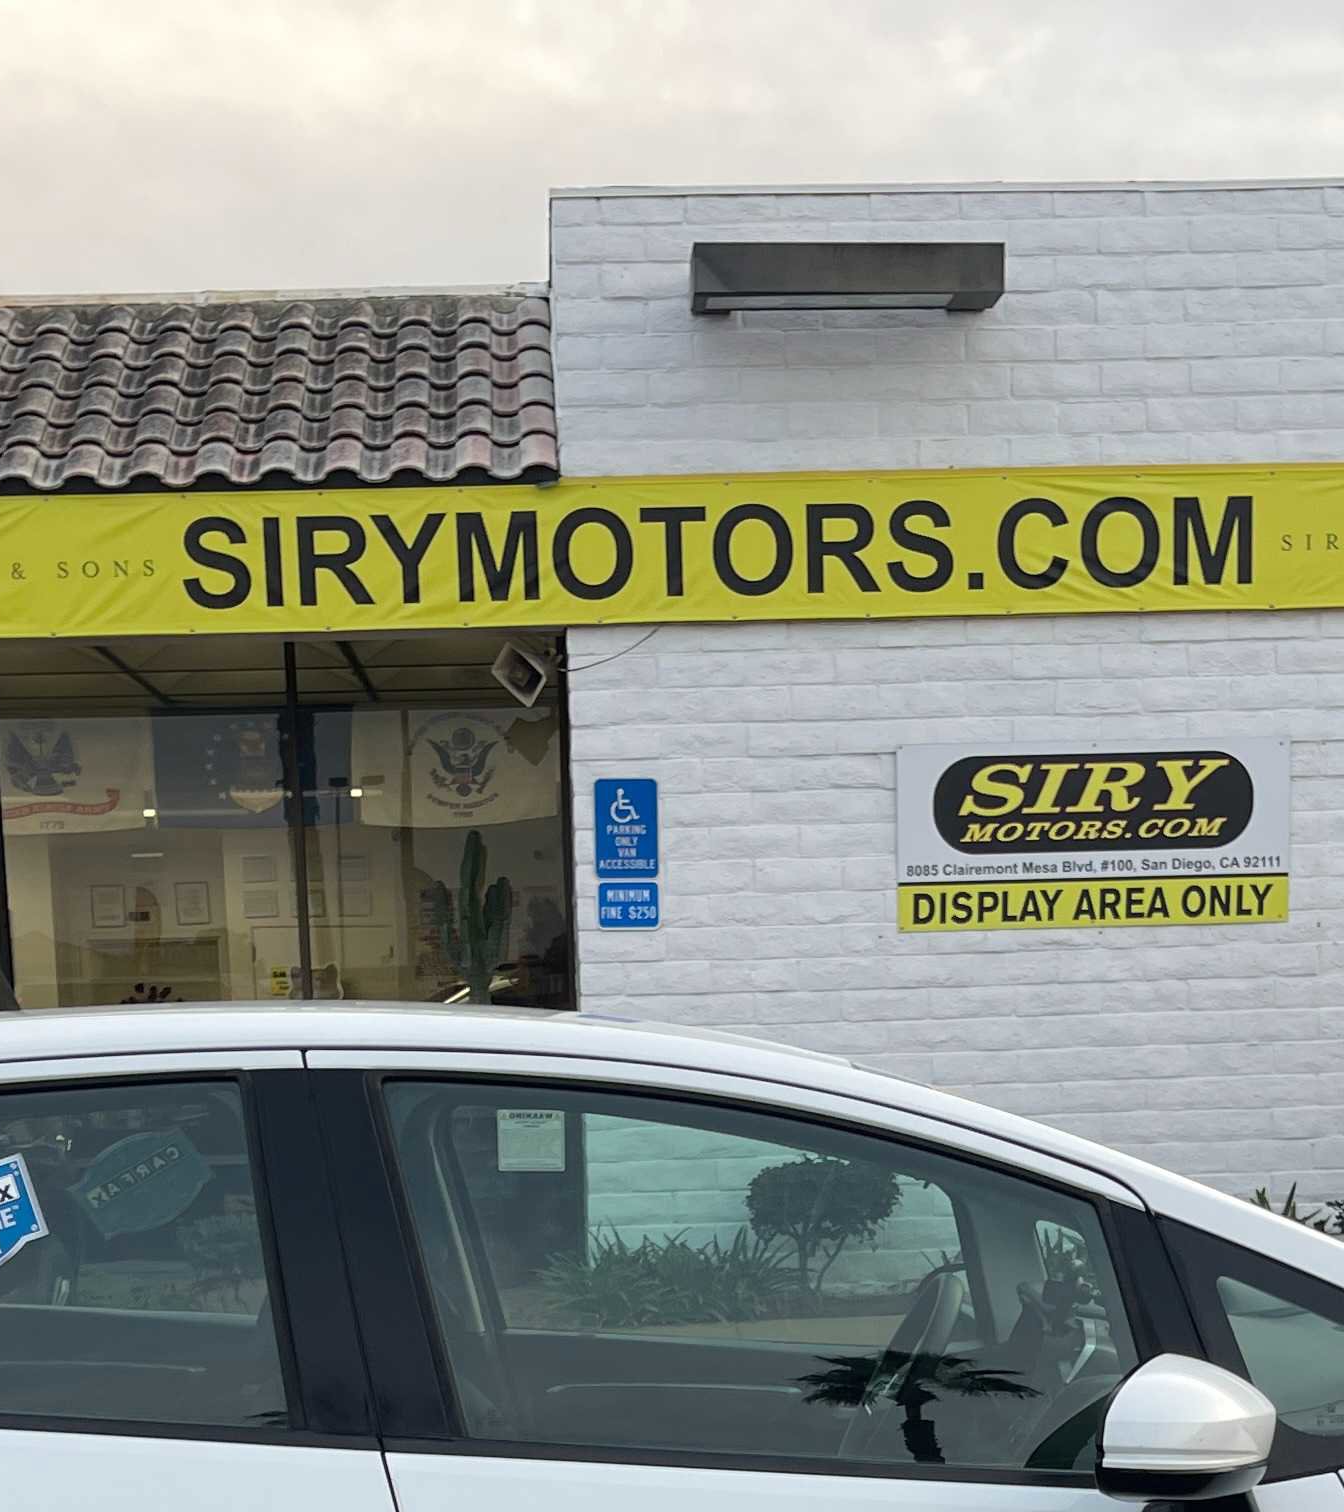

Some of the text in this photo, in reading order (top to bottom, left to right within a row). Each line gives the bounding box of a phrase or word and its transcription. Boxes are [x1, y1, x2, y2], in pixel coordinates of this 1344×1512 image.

[183, 496, 1254, 611] SIRYMOTORS.COM
[11, 562, 26, 580] &
[57, 560, 155, 578] SONS
[958, 758, 1230, 818] SIRY
[606, 824, 647, 835] PARKING
[959, 816, 1228, 844] MOTORS.COM
[599, 859, 656, 870] ACCESSIBLE
[906, 855, 1282, 877] 8085 Clairemont Mesa Blvd, #100, San Diego, CA 92111
[606, 889, 650, 901] MINIMUM
[913, 884, 1274, 925] DISPLAY AREA ONLY
[601, 905, 657, 920] FINE $250
